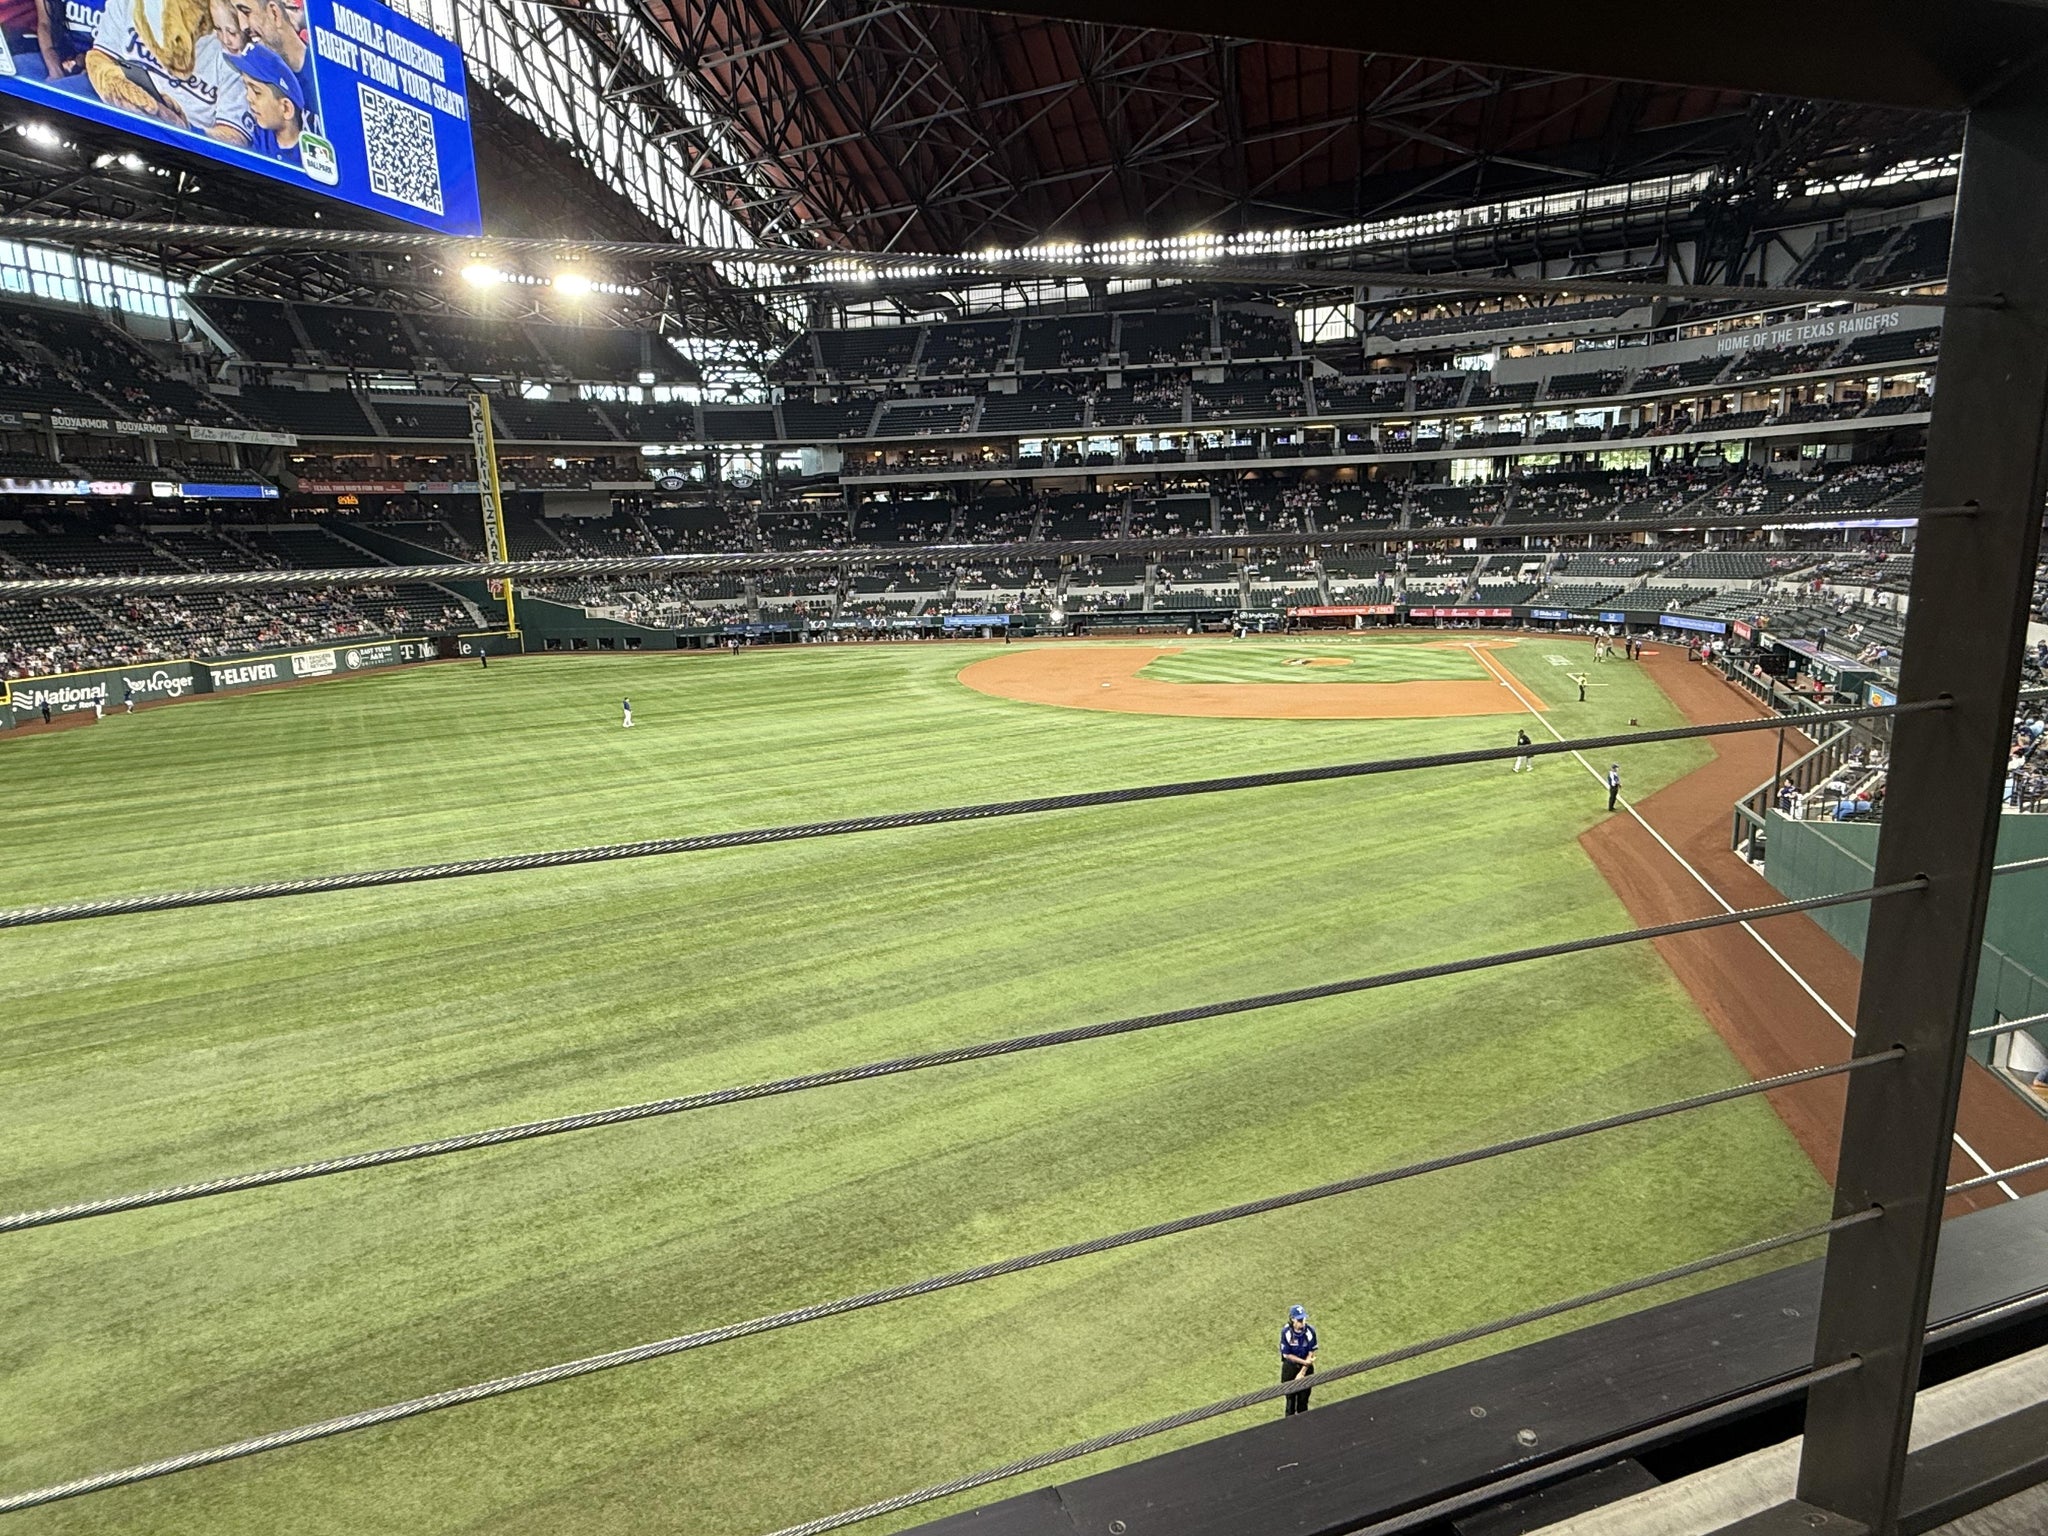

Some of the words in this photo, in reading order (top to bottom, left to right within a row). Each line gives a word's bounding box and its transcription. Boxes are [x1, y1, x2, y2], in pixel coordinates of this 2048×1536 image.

[332, 1, 385, 53] MOBILE
[385, 29, 446, 82] ORDERING
[315, 25, 358, 71] RIGHT
[360, 47, 399, 90] FROM
[398, 65, 433, 105] YOUR
[432, 82, 467, 121] SEAT!
[306, 158, 333, 175] BALLPARK
[1717, 335, 1751, 352] HOME
[1753, 332, 1768, 347] OF
[1771, 328, 1793, 344] THE
[1797, 323, 1834, 340] TEXAS
[1838, 312, 1899, 334] RANGERS
[50, 415, 109, 430] BODYARMOR
[115, 420, 168, 434] BODYARMOR
[147, 670, 194, 698] Kroger
[62, 702, 76, 712] Car
